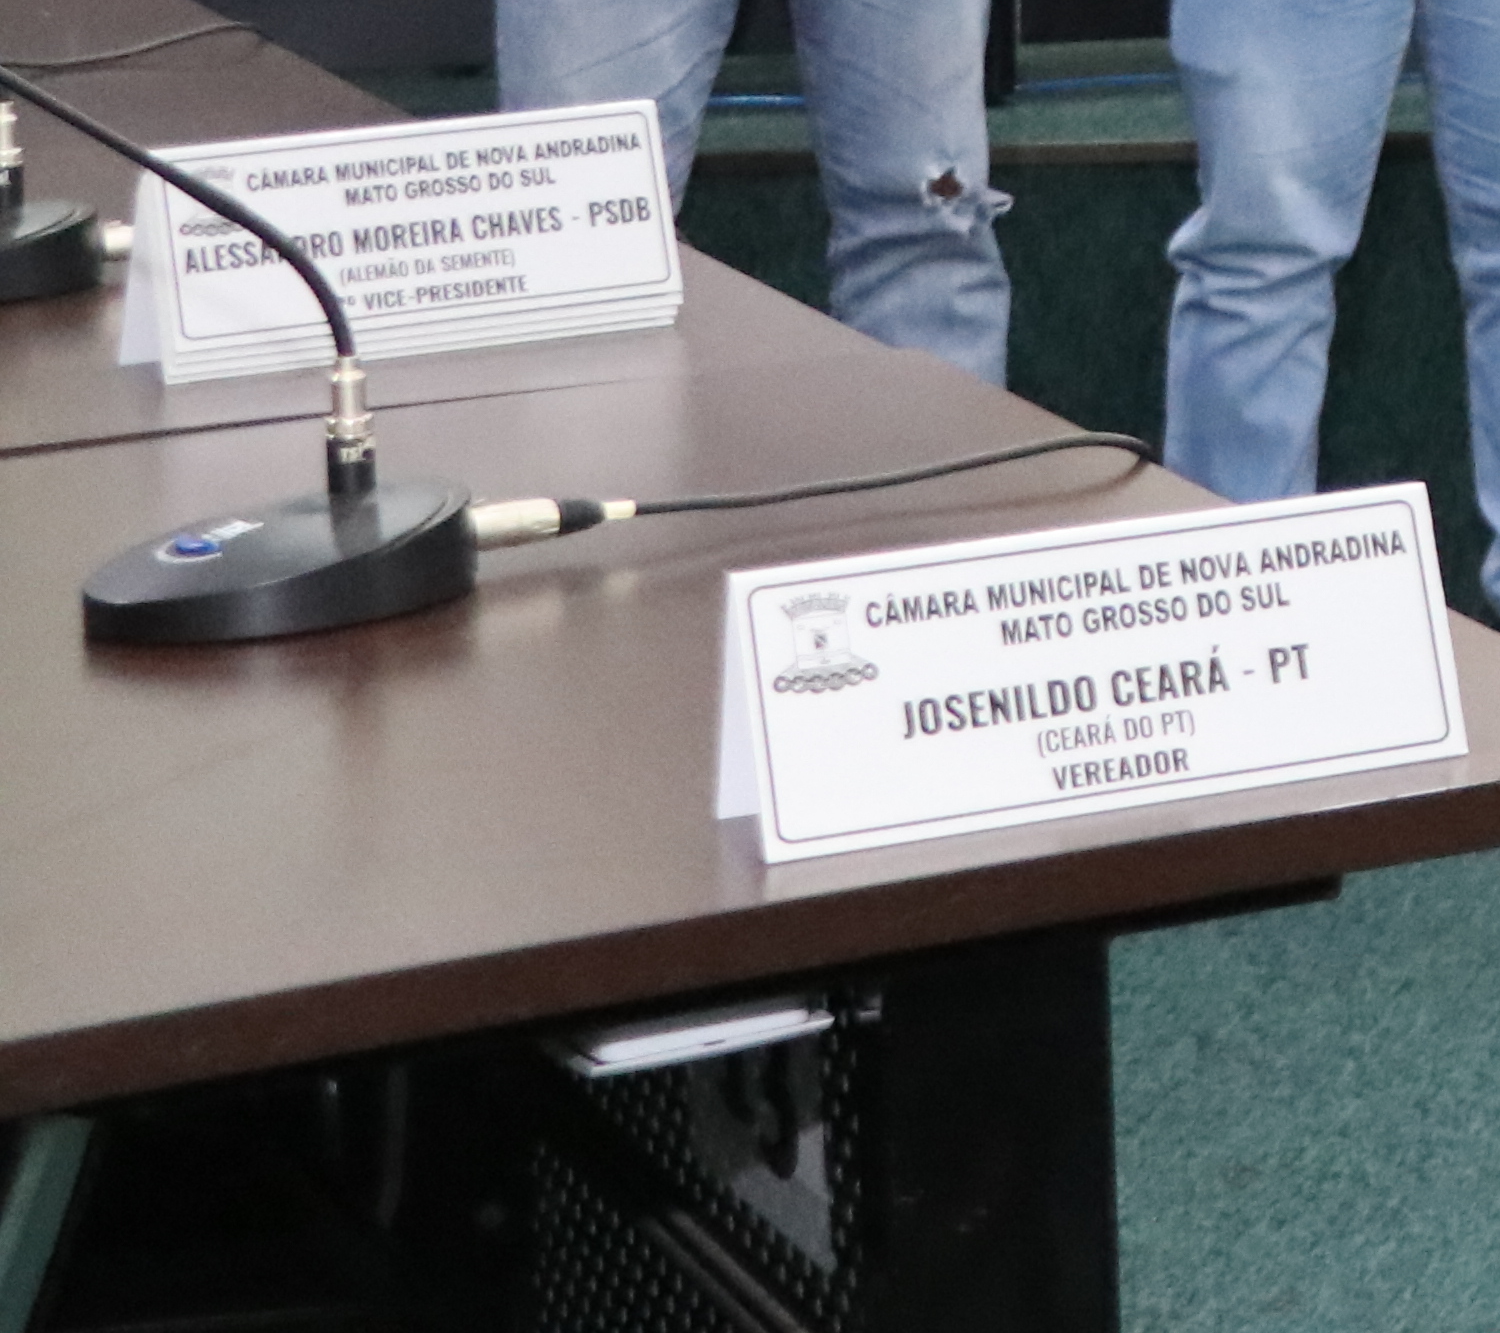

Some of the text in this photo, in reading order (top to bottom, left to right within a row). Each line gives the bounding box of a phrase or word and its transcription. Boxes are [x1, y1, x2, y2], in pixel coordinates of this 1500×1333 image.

[335, 155, 440, 182] MUNICIPAL
[447, 149, 470, 170] DE
[477, 144, 526, 166] NOVA
[533, 132, 641, 162] ANDRADINA
[345, 166, 556, 207] MATO GROSSO DO SUL
[186, 231, 343, 274] ALESSADRO
[353, 217, 465, 254] MOREIRA
[471, 205, 562, 243] CHAVES
[588, 196, 651, 229] PSDB
[340, 247, 517, 287] (ALEMÃO DA SEMENTE)
[363, 275, 528, 311] VICE-PRESIDENTE
[864, 529, 1406, 628] CÂMARA MUNICIPAL DE NOVA ANDRADINA
[1000, 582, 1290, 647] MATO GROSSO DO SUL
[902, 674, 1098, 741] JOSENILDO
[1111, 646, 1230, 708] CEARÁ
[1268, 643, 1312, 684] PT
[1036, 708, 1196, 760] (CEARÁ DO PT)
[1052, 747, 1191, 793] VEREADOR
